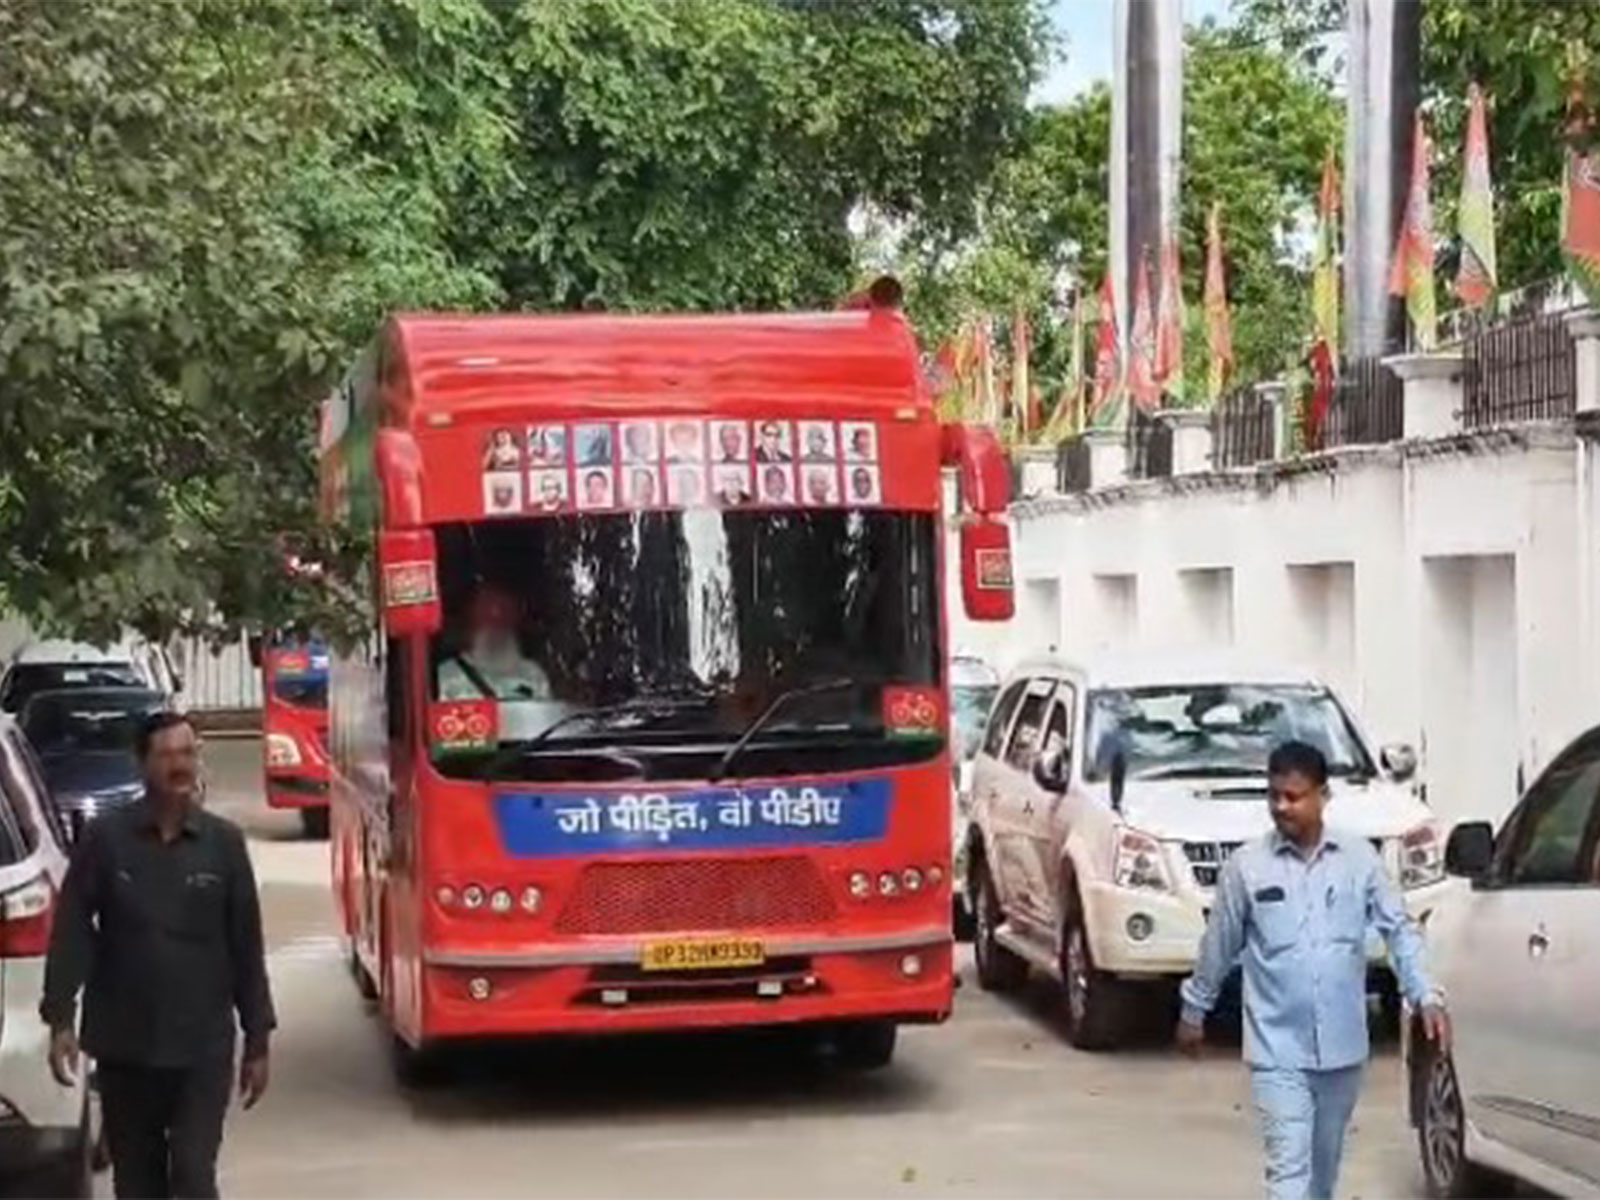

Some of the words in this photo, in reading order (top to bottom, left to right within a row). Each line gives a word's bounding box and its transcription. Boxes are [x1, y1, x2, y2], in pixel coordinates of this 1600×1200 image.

[554, 796, 601, 833] जो
[608, 793, 707, 841] पीड़ित,
[717, 788, 752, 827] वो
[760, 787, 841, 826] पीडीए
